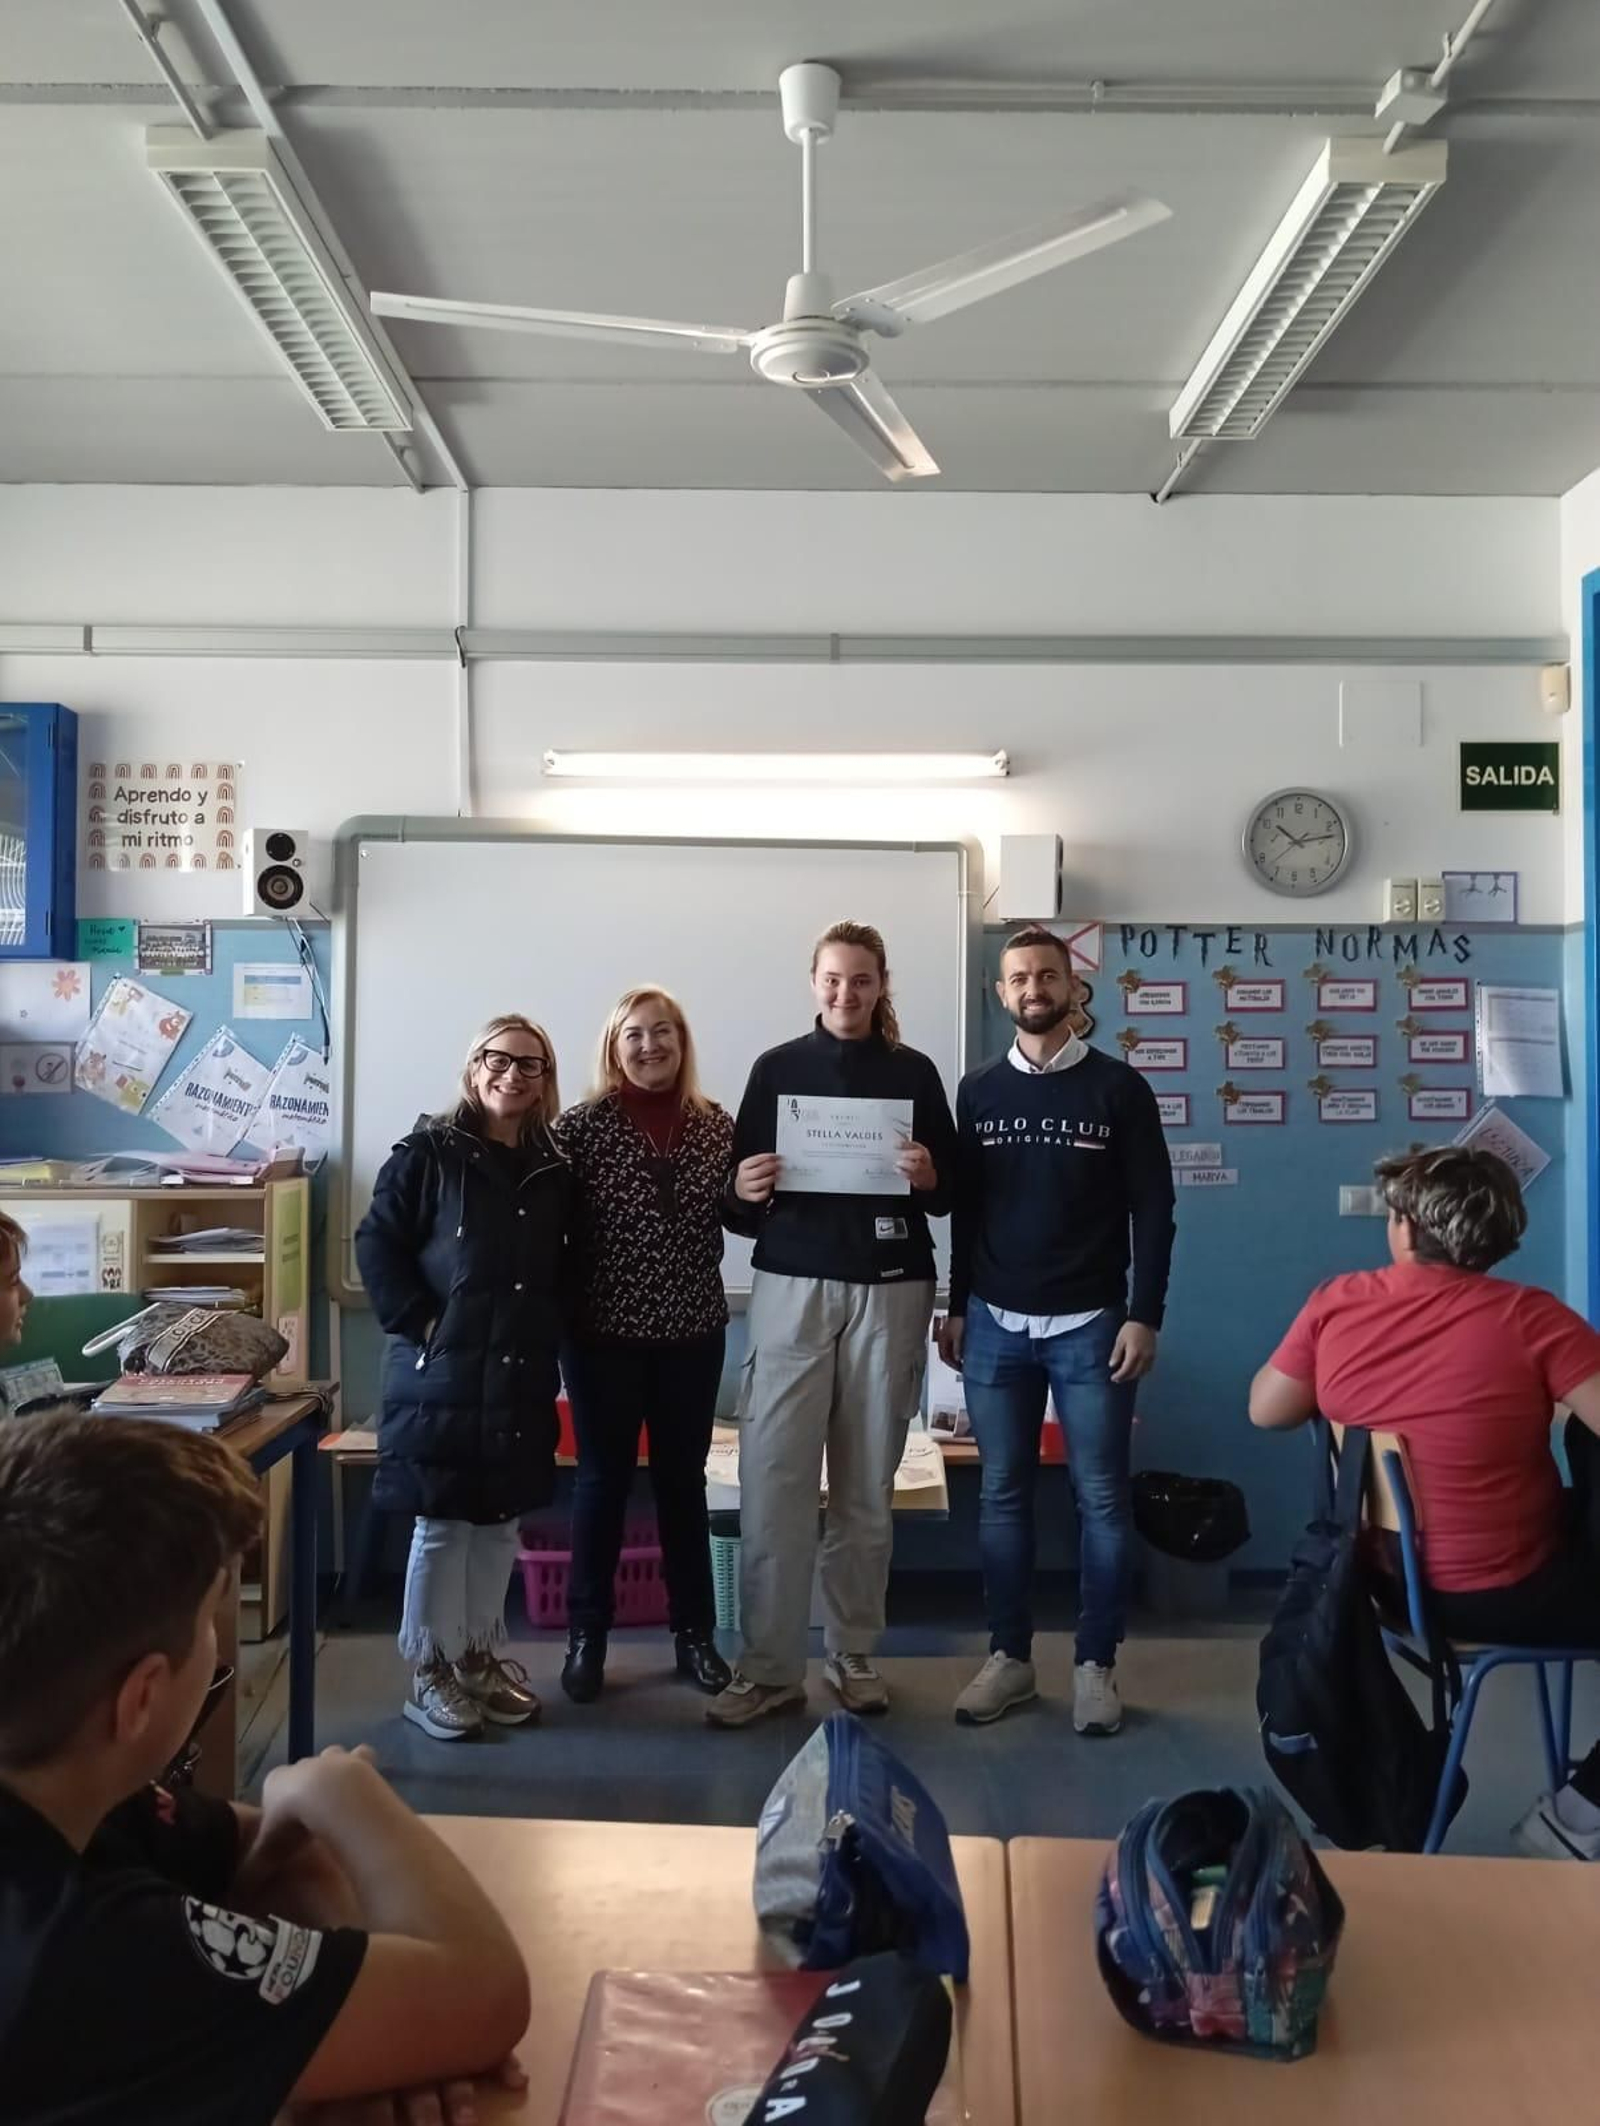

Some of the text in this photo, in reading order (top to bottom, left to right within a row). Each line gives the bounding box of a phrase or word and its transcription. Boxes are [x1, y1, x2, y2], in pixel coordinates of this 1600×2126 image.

[1466, 765, 1554, 785] SALIDA
[114, 786, 208, 806] Aprendo y
[117, 809, 205, 825] disfruto a
[122, 831, 194, 847] mi ritmo
[1120, 924, 1471, 968] POTTER NORMAS
[807, 1129, 841, 1139] STELLA
[975, 1117, 1111, 1138] POLO CLUB
[996, 1134, 1071, 1146] ORIGINAL
